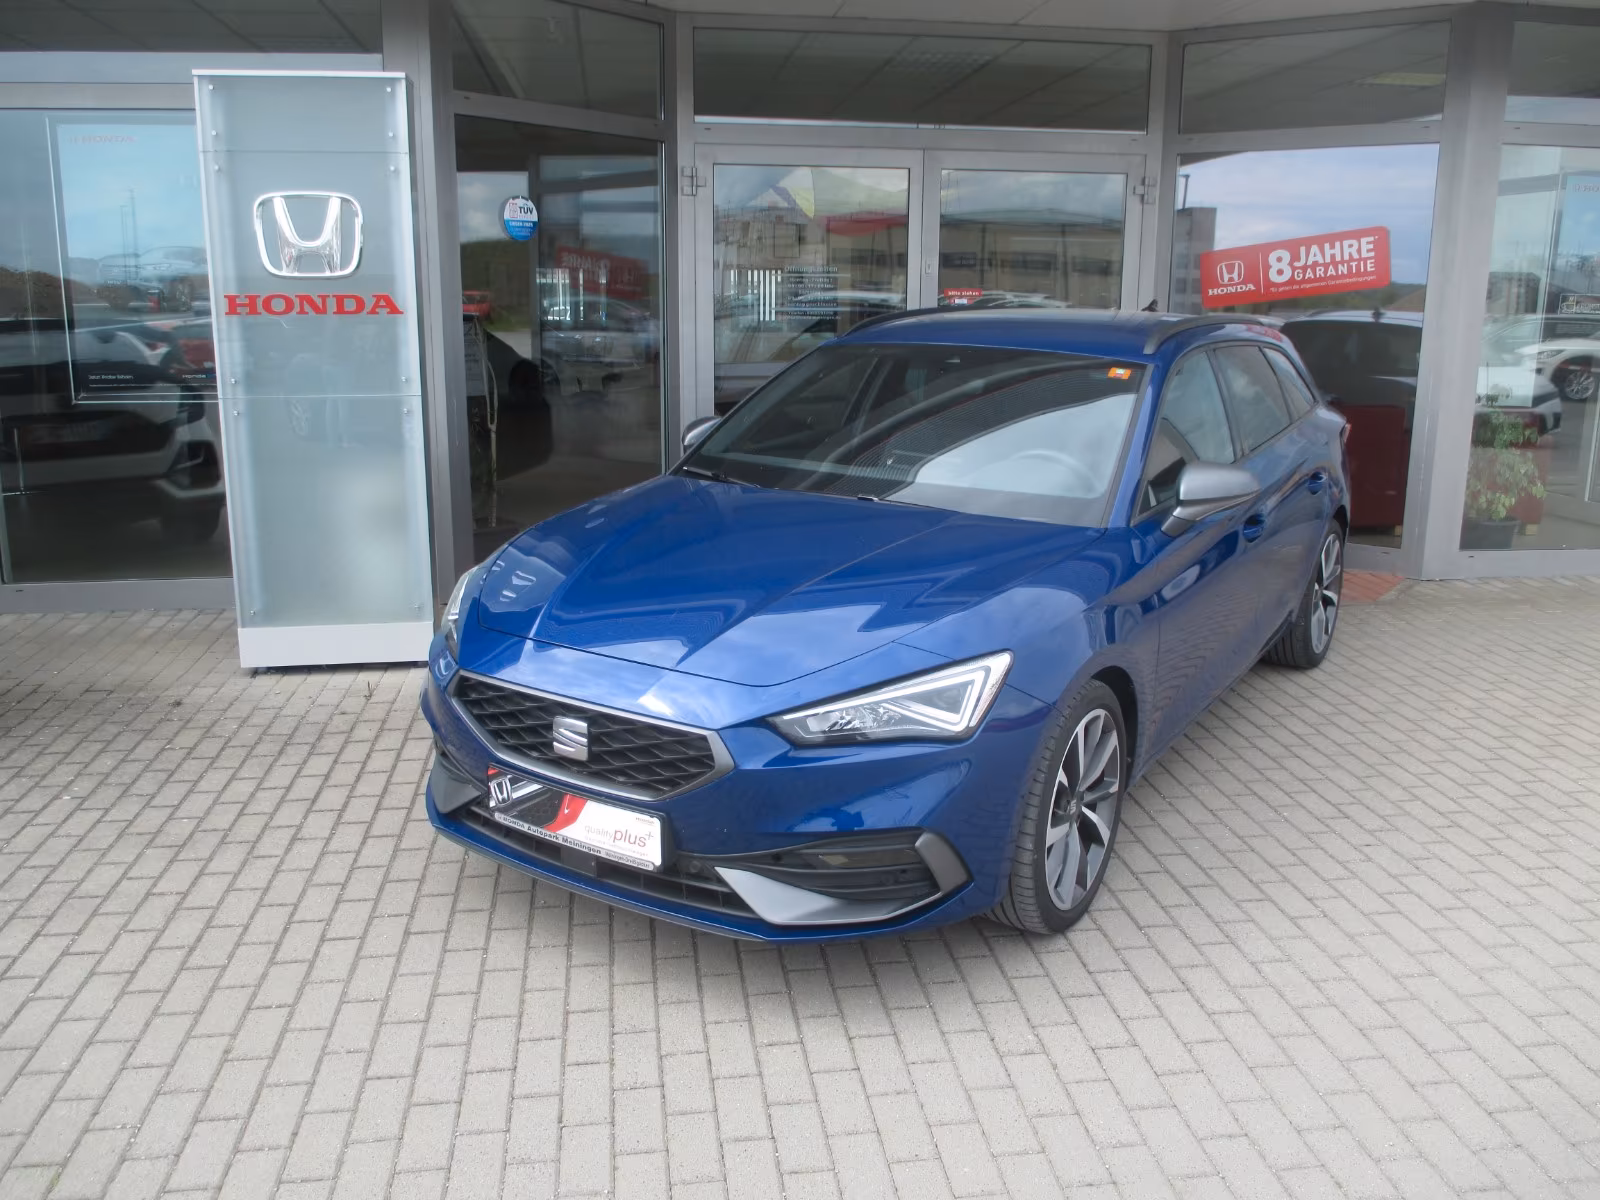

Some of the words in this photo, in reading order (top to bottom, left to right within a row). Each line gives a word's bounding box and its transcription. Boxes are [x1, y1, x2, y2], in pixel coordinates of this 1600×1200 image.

[1268, 249, 1293, 283] 8
[1294, 259, 1376, 281] GARANTIE
[1207, 283, 1256, 296] HONDA
[223, 294, 404, 316] HONDA
[502, 816, 526, 829] HONDA
[527, 825, 560, 843] Autopark
[561, 836, 603, 855] Meiningen
